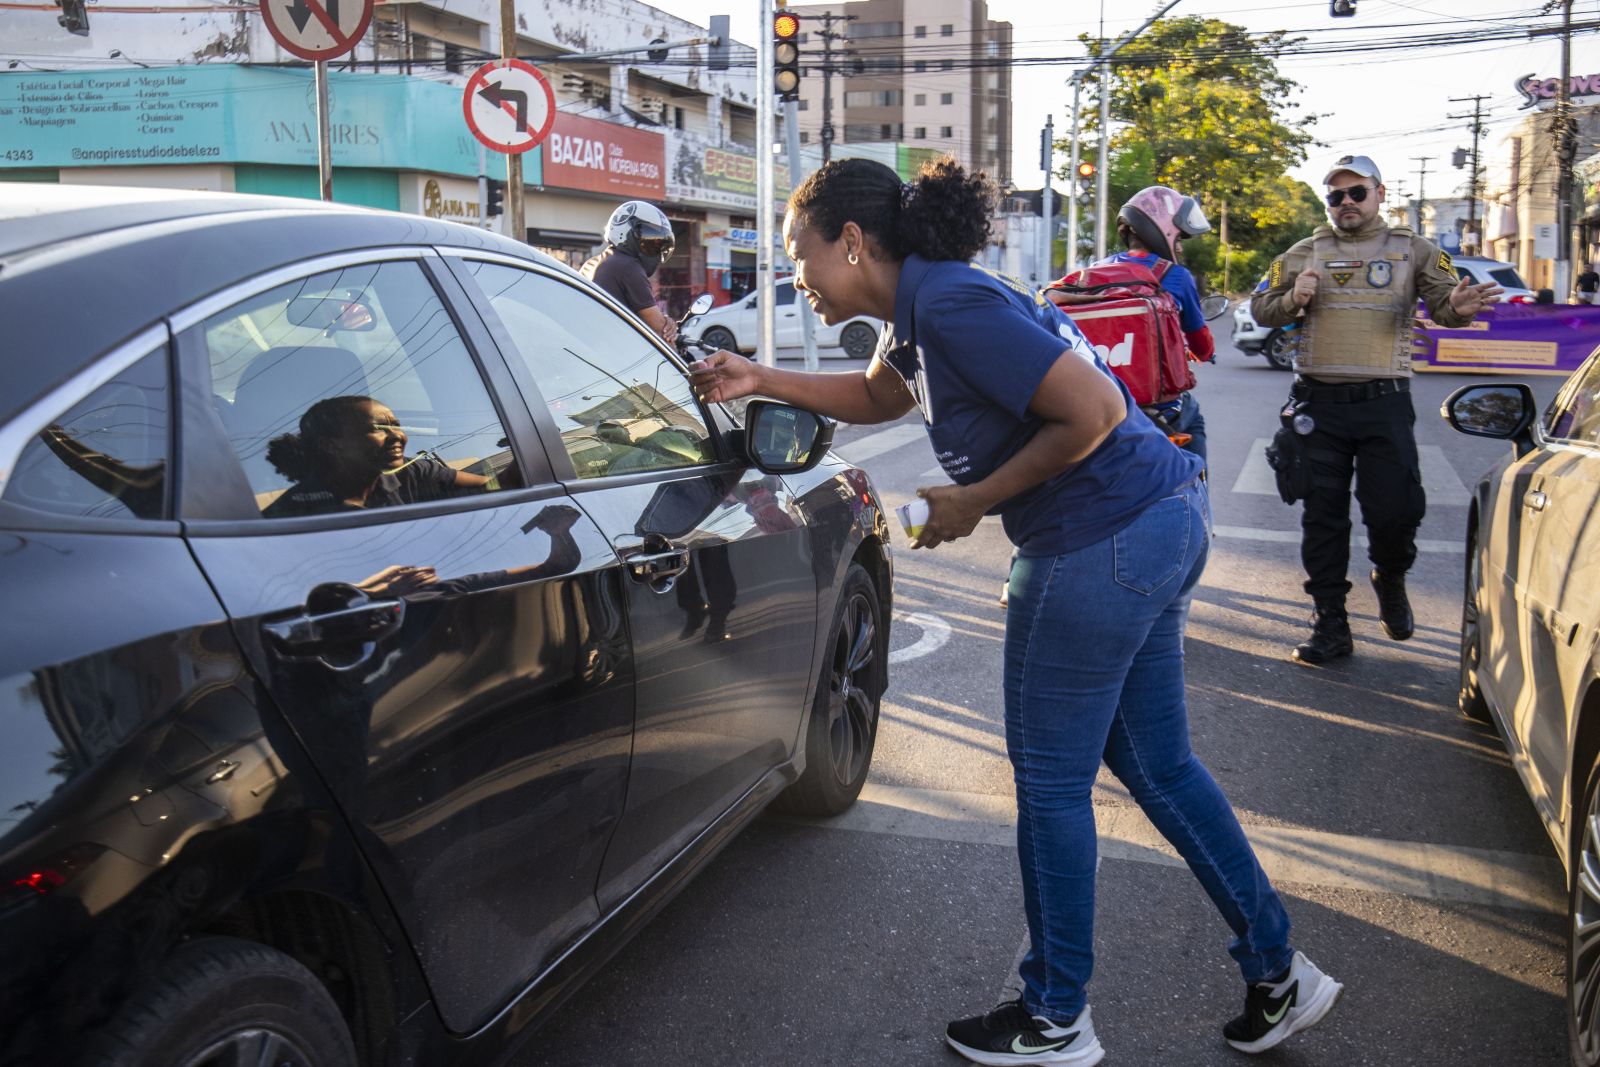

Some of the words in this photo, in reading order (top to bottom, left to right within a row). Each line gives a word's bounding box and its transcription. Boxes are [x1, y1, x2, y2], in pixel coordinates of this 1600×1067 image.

[88, 78, 131, 91] Corporal
[138, 77, 165, 88] Mega
[167, 75, 187, 85] Hair
[64, 93, 74, 101] de
[22, 105, 54, 116] Design
[56, 104, 67, 113] de
[69, 102, 131, 113] Sobrancelhas
[140, 100, 175, 110] Cachos
[178, 99, 218, 111] Crespos
[23, 117, 76, 127] Maquiagem
[142, 124, 174, 134] Cortes
[264, 120, 312, 143] ANA
[327, 123, 380, 146] IRES
[71, 144, 220, 161] @anapiresstudiodebeleza
[550, 132, 605, 171] BAZAR
[609, 157, 640, 177] MORENA
[640, 161, 660, 179] ROSA
